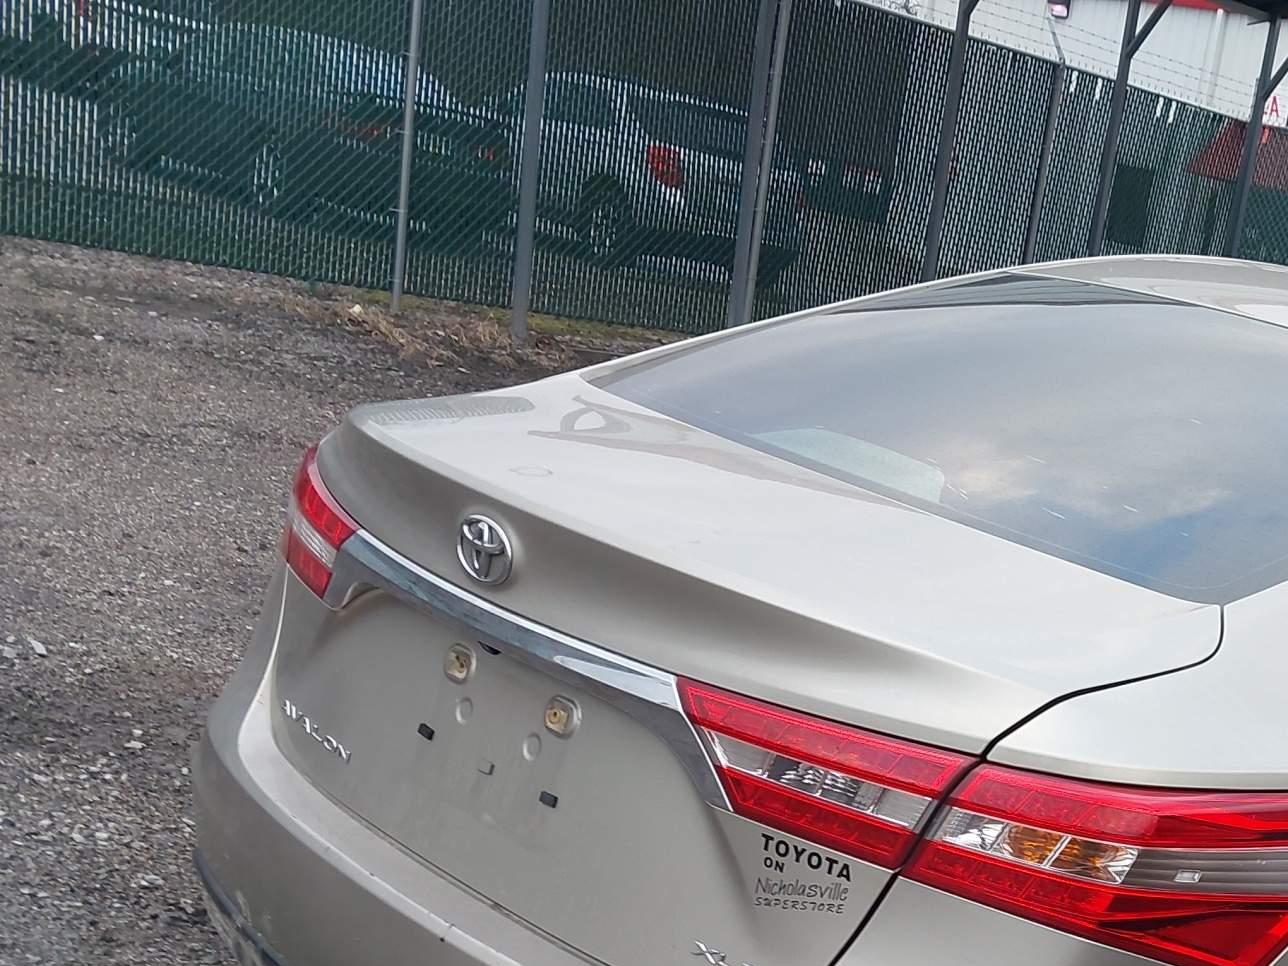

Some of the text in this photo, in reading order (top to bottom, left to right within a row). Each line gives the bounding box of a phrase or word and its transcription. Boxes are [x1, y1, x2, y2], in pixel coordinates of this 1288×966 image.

[281, 699, 351, 764] AVALON
[761, 833, 851, 882] TOYOTA
[763, 857, 785, 873] ON
[755, 877, 849, 901] Nicholasville
[755, 897, 845, 914] SUPERSTORE
